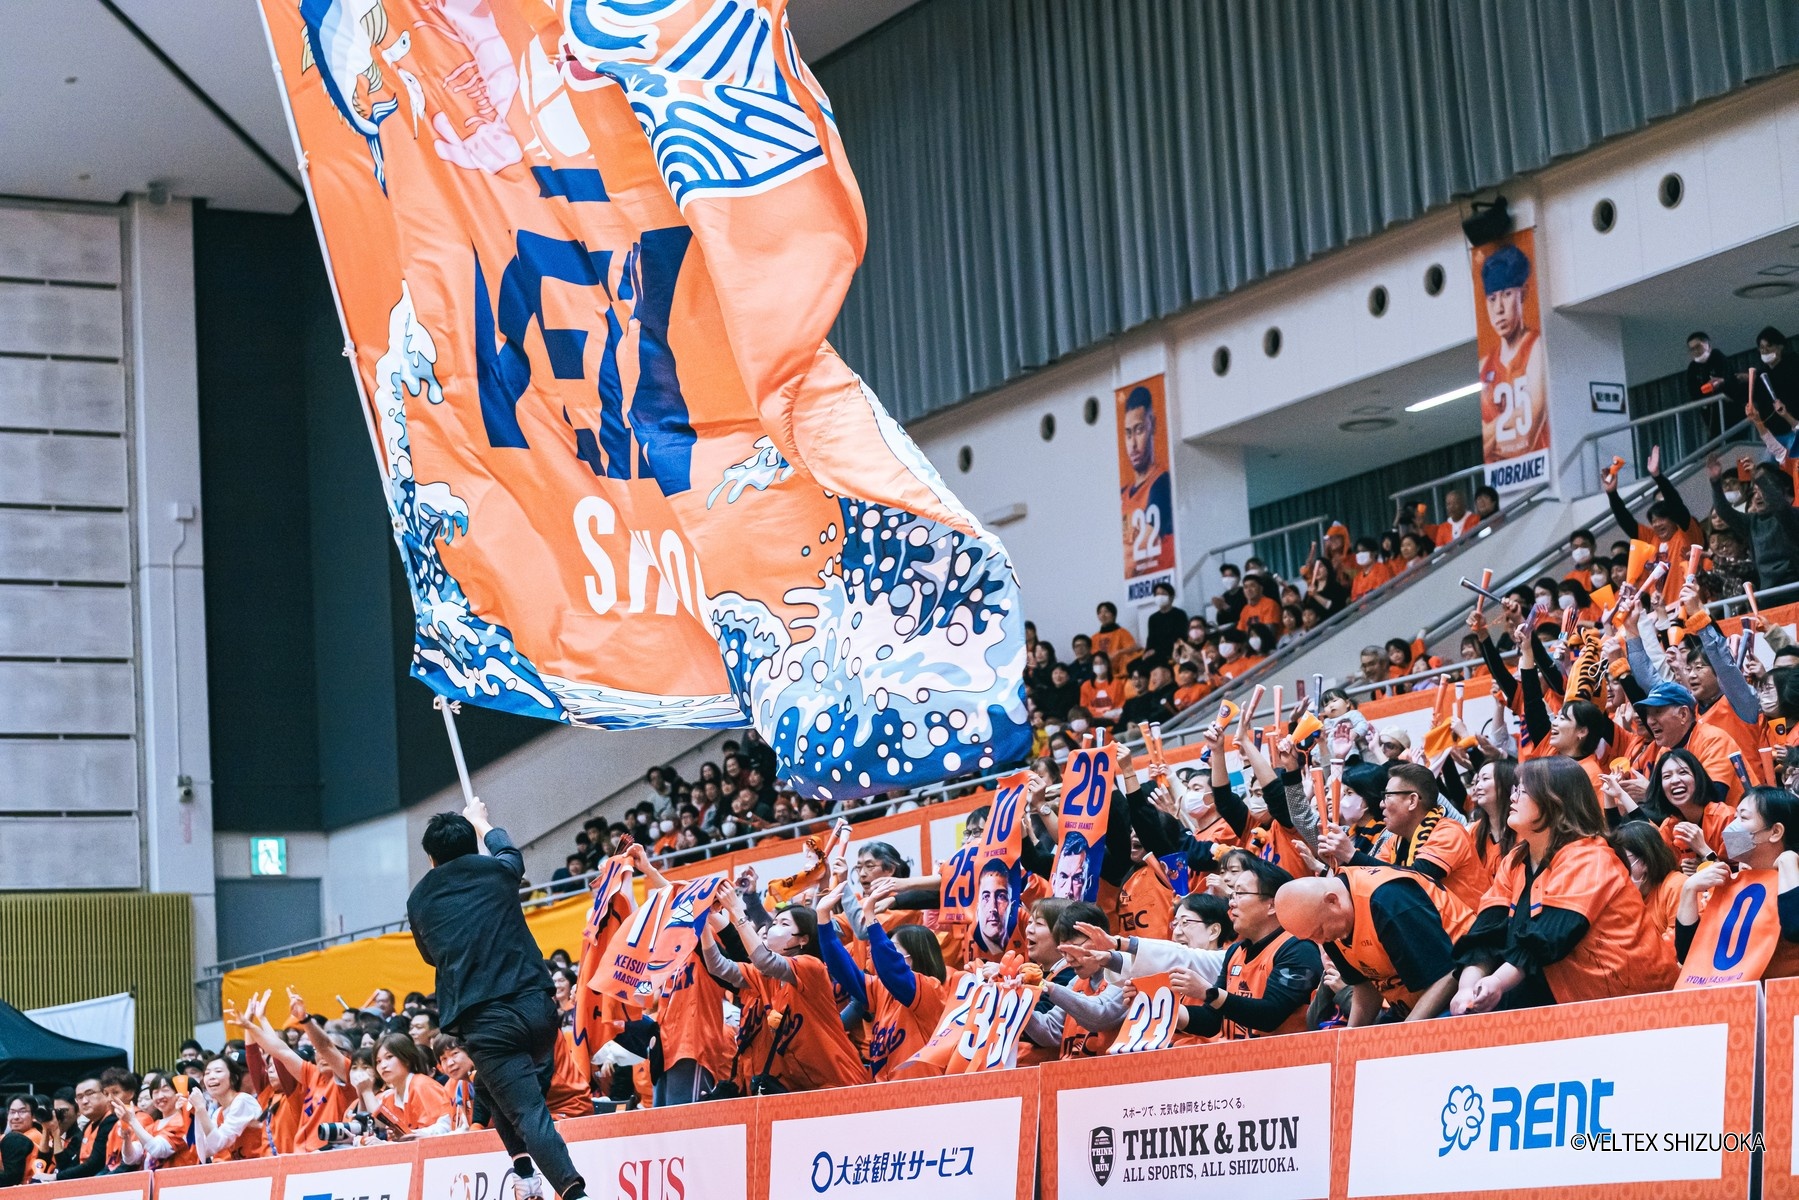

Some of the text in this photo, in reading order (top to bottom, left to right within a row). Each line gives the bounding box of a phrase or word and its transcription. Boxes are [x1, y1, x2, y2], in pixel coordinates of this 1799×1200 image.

[1494, 376, 1533, 442] 25
[1491, 455, 1546, 489] NOBRAKE!
[1132, 503, 1162, 561] 22
[1062, 751, 1109, 817] 26
[986, 783, 1025, 846] 10
[943, 846, 979, 908] 25
[1713, 883, 1766, 971] 0
[614, 953, 646, 975] KEISU
[1106, 985, 1176, 1055] 33
[1091, 1147, 1113, 1156] THINK
[1100, 1155, 1105, 1164] &
[1123, 1116, 1300, 1161] THINK & RUN
[617, 1156, 686, 1200] SUS
[834, 1146, 975, 1186] 大鉄観光サービス
[1095, 1163, 1110, 1172] RUN
[1123, 1156, 1299, 1182] ALL SPORTS, ALL SHIZUOKA.
